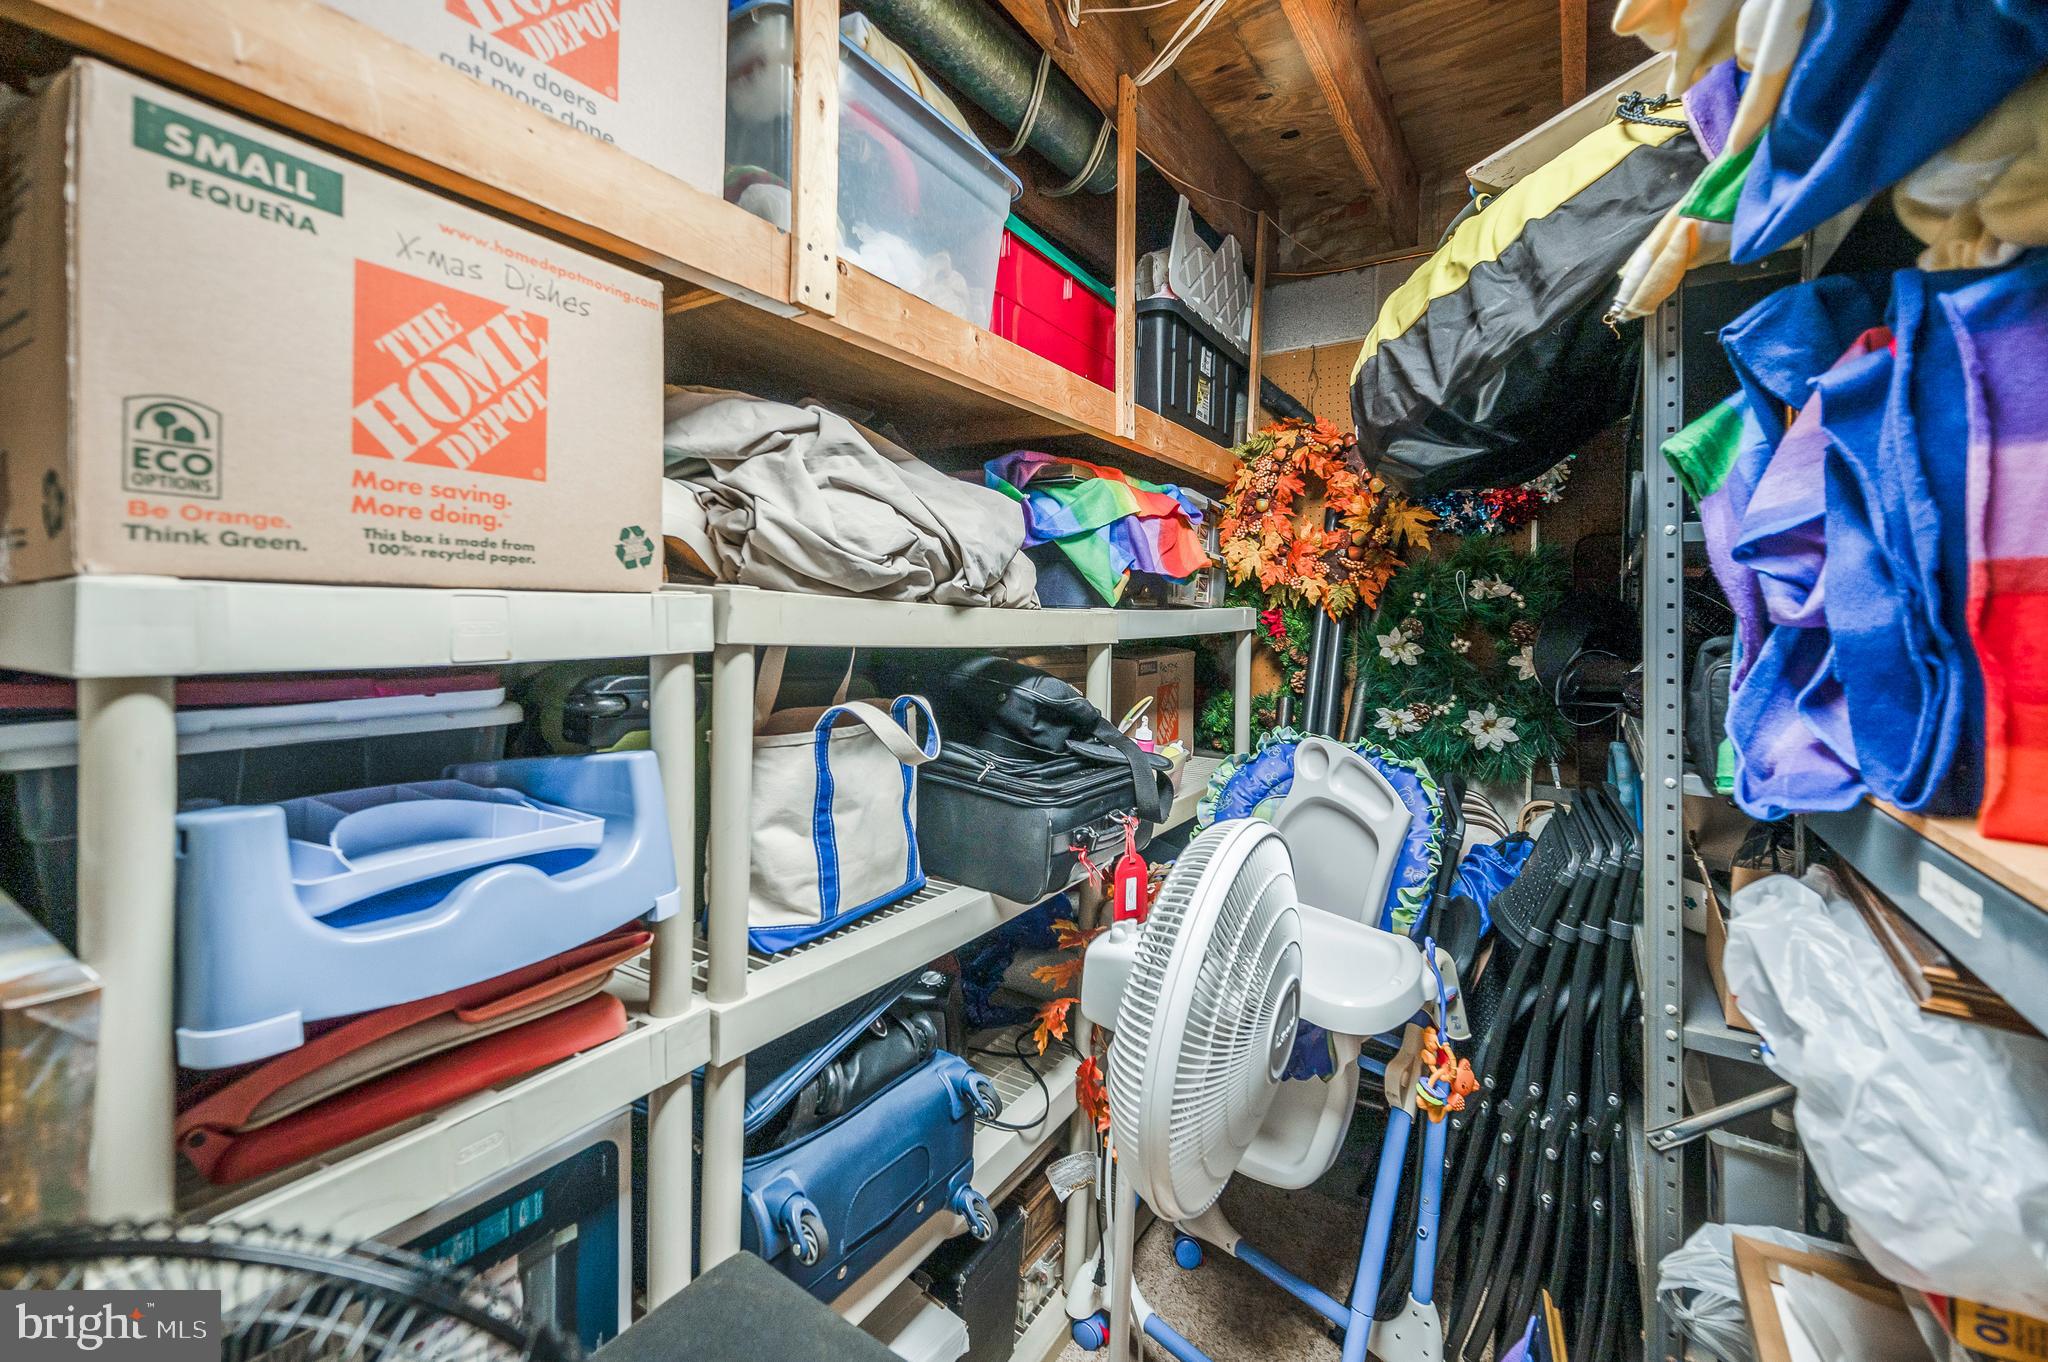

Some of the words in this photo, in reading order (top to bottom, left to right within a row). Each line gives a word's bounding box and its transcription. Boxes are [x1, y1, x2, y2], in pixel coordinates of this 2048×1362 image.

[519, 0, 621, 63] DEPOT
[469, 34, 525, 79] How
[533, 72, 598, 116] doers
[164, 122, 316, 200] SMALL
[168, 171, 318, 235] PEQUEÑA
[396, 231, 483, 280] X-mas
[504, 263, 592, 317] Dishes
[437, 223, 660, 311] www.homedepotmoving.com
[373, 302, 464, 368] THE
[352, 304, 548, 462] HOME
[435, 374, 548, 470] DEPOT
[131, 472, 212, 493] OPTIONS
[133, 447, 213, 476] ECO
[351, 469, 423, 496] More
[430, 484, 512, 510] saving.
[123, 523, 210, 546] Think
[219, 530, 308, 551] Green.
[127, 499, 169, 519] Be
[180, 503, 292, 531] Orange.
[351, 495, 423, 520] More
[430, 503, 502, 532] doing.
[363, 528, 397, 541] This
[402, 530, 433, 544] box
[439, 534, 450, 545] is
[455, 535, 497, 549] made
[501, 539, 536, 552] from
[368, 542, 417, 557] 100%
[421, 546, 486, 561] recycled
[490, 553, 536, 566] paper.
